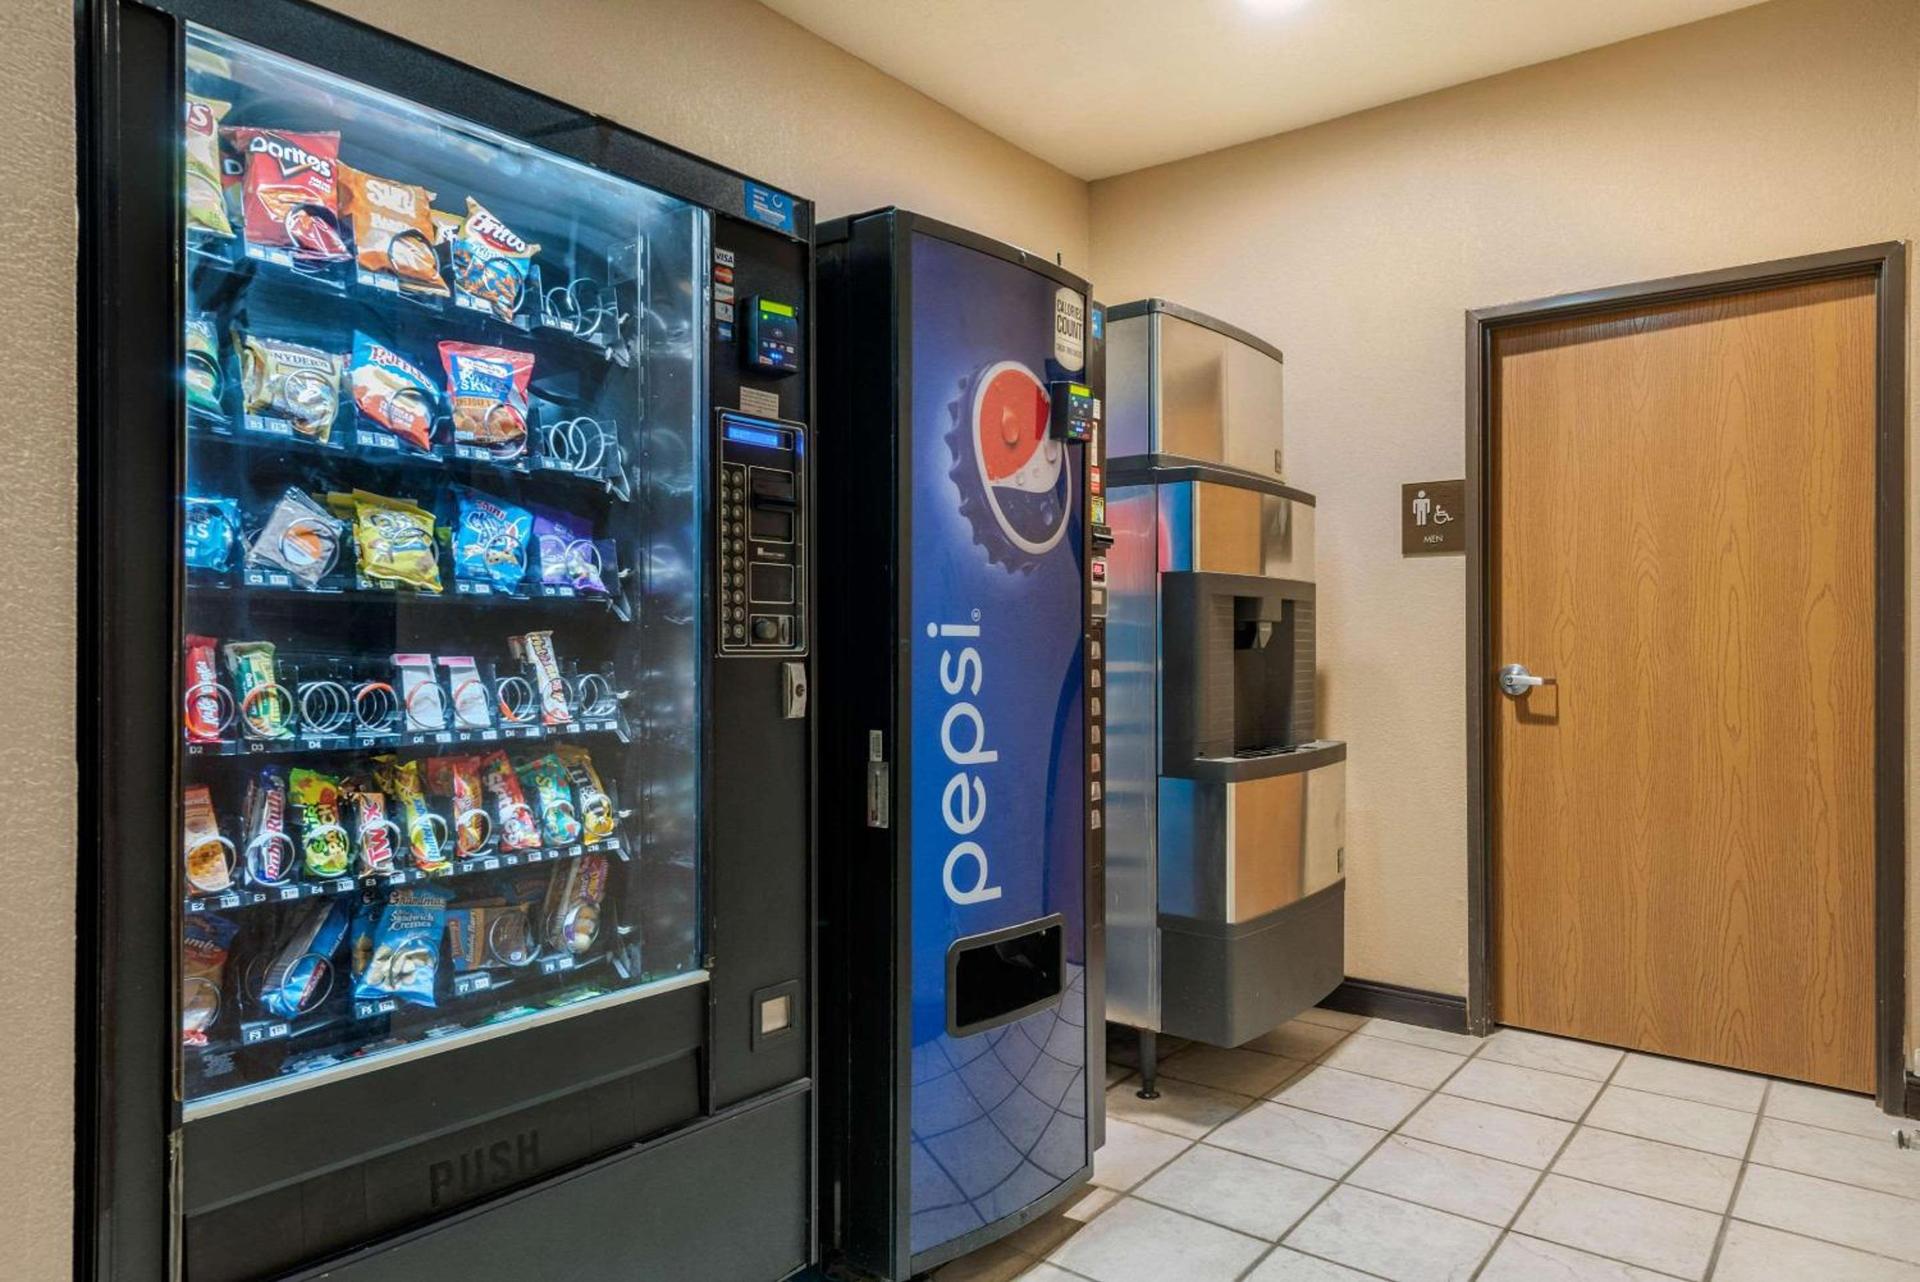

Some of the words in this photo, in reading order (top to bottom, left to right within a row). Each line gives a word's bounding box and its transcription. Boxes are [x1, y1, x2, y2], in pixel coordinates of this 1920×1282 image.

[716, 252, 733, 264] VISA
[1057, 315, 1081, 340] COUNT
[1424, 534, 1444, 544] MEN
[927, 622, 1002, 905] pepsi
[359, 801, 394, 867] TWX
[192, 902, 205, 911] E2
[430, 1129, 540, 1208] PUSH
